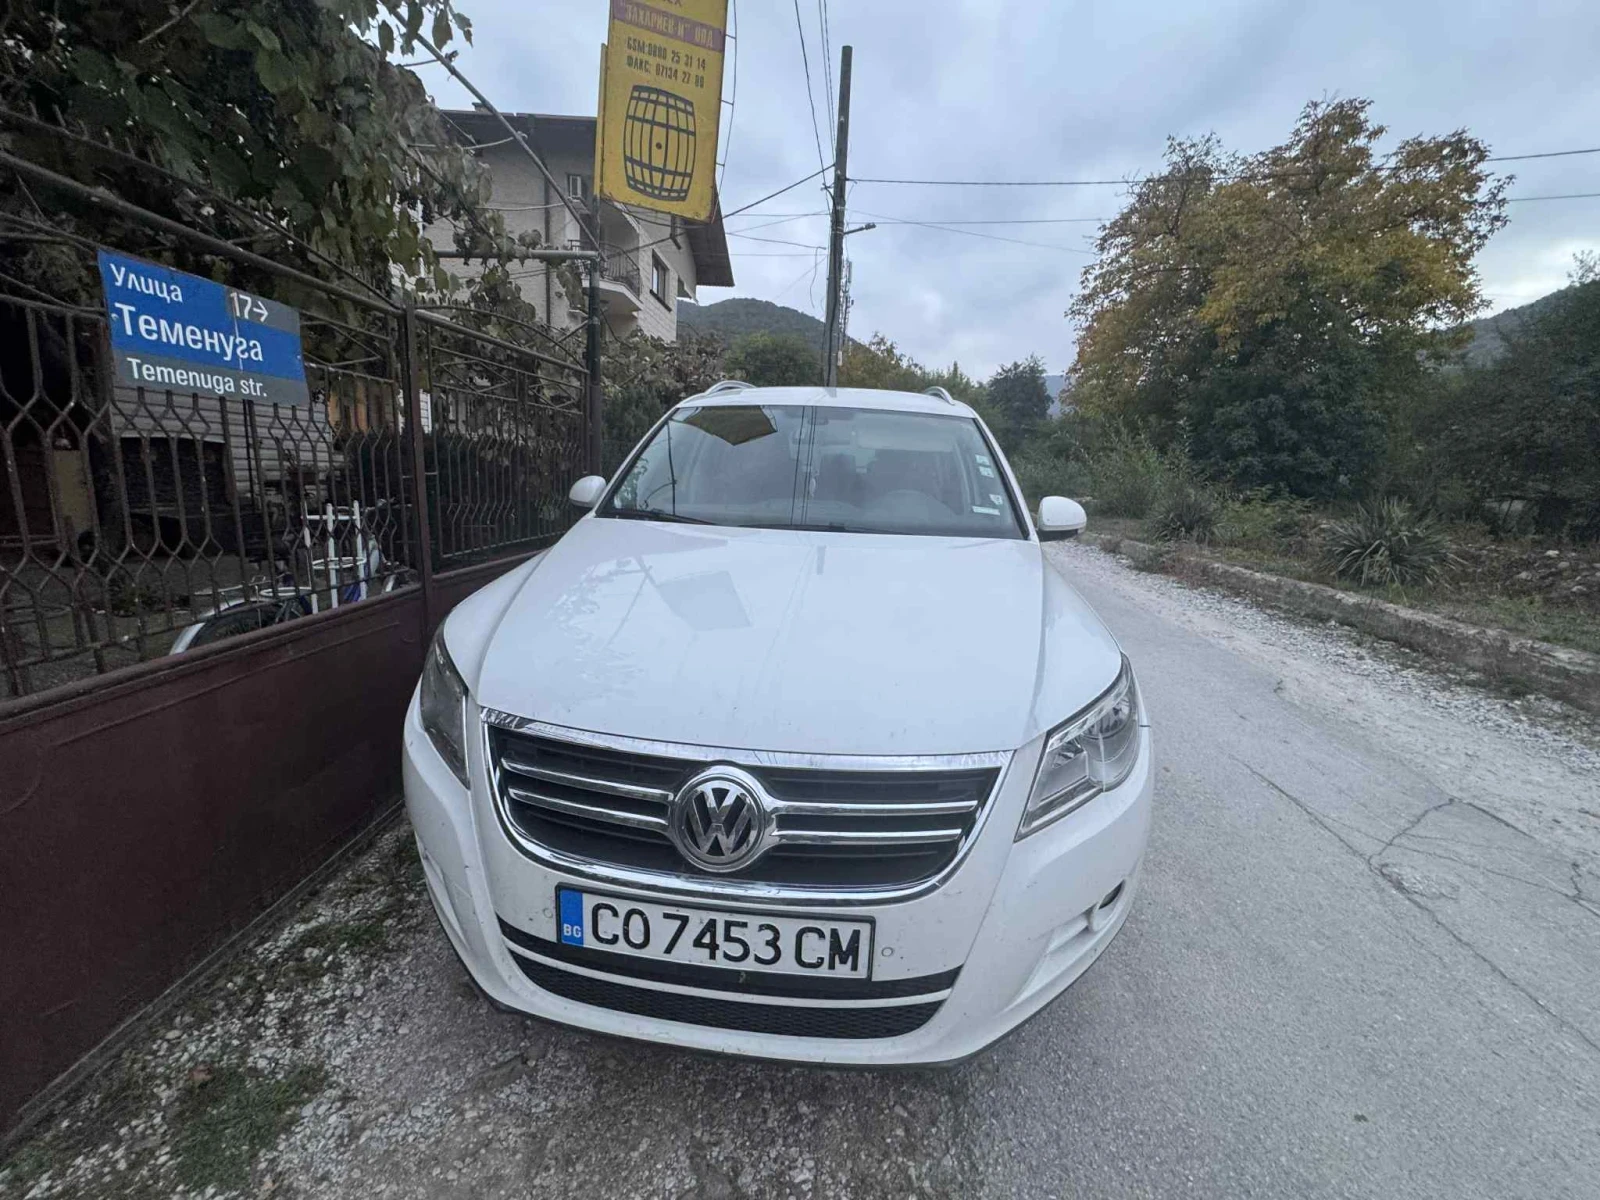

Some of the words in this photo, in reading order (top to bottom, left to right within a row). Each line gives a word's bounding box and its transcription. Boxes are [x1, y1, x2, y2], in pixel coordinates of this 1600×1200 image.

[671, 50, 680, 64] 25
[697, 57, 706, 71] 14
[682, 71, 690, 84] 27
[229, 291, 252, 320] 17
[114, 302, 264, 362] Теменуга
[127, 357, 235, 395] Temenuga
[240, 379, 268, 397] str.
[563, 922, 582, 938] BG
[662, 912, 782, 966] 7453
[794, 926, 861, 972] CM
